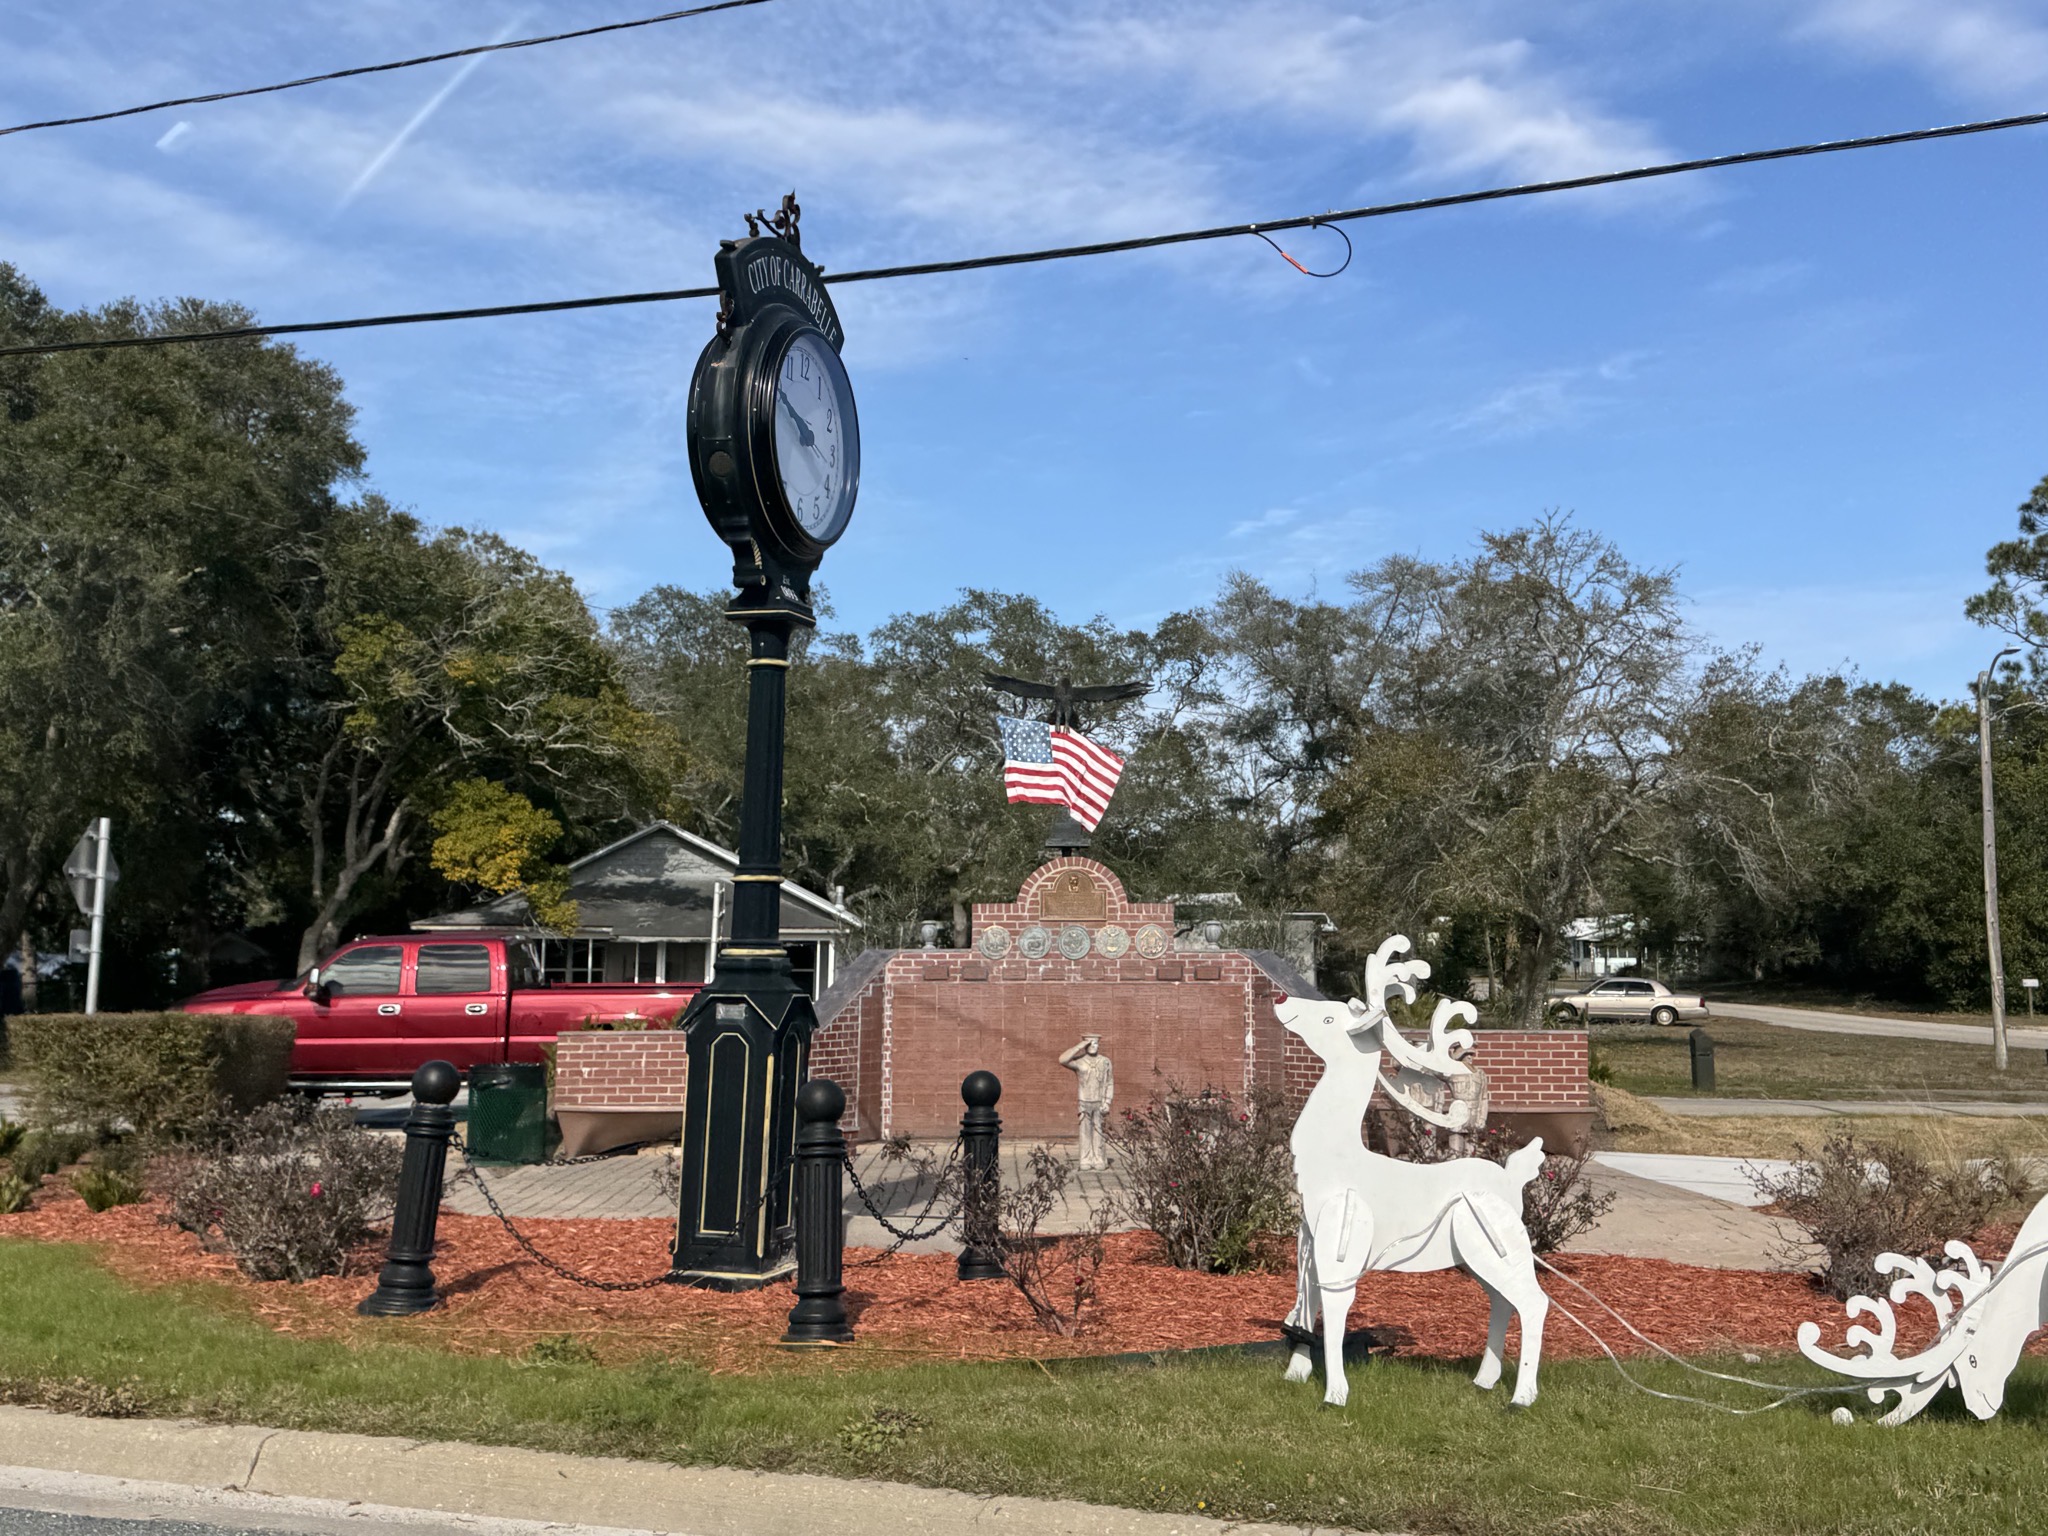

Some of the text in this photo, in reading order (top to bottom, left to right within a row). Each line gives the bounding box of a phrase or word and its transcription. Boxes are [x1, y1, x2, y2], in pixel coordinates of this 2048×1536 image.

[748, 255, 837, 343] CITY OF CARRABELLE
[786, 354, 793, 382] 11
[800, 353, 810, 381] 12
[826, 408, 833, 433] 2
[830, 444, 835, 468] 3
[823, 474, 830, 499] 4
[797, 497, 803, 522] 6
[812, 496, 820, 520] 5
